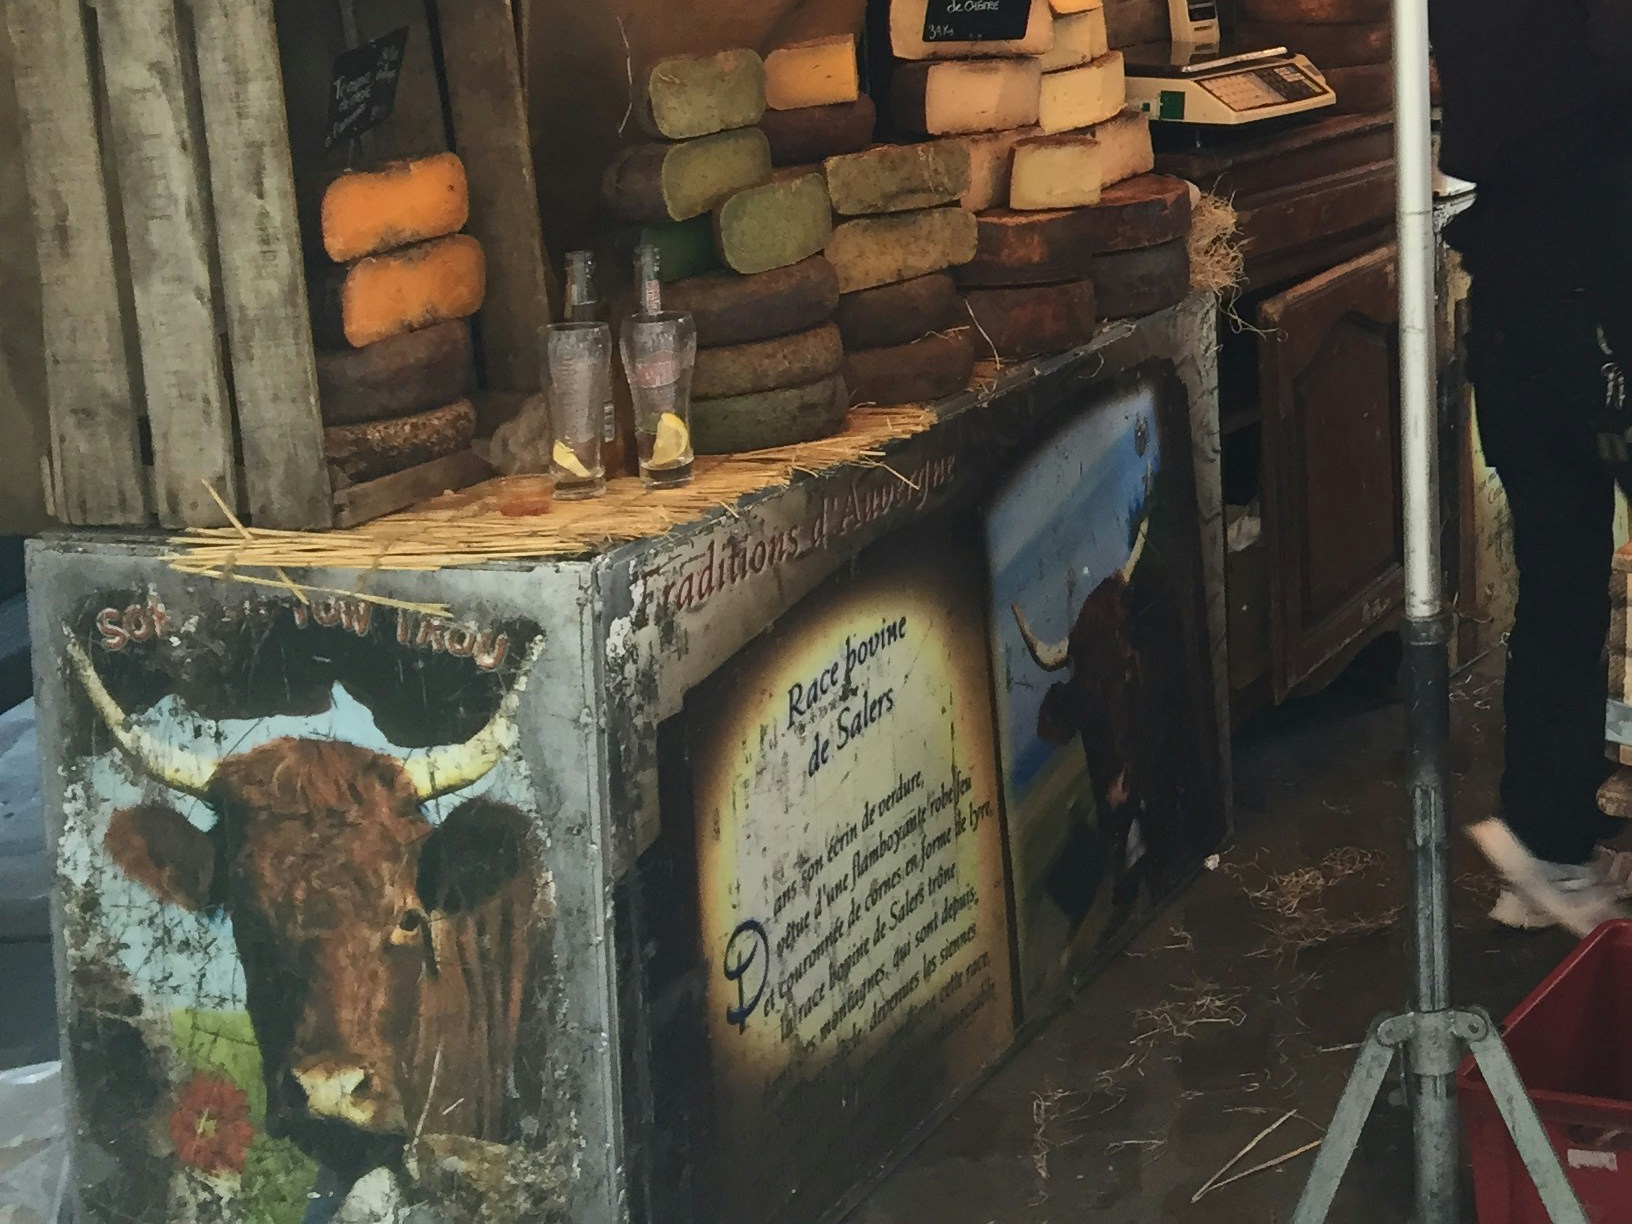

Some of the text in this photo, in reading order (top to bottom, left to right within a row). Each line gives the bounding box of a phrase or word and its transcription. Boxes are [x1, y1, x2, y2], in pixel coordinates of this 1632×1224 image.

[946, 0, 962, 14] de
[787, 616, 907, 732] Race bovine
[808, 687, 895, 777] de Salers
[862, 801, 877, 832] de
[878, 770, 924, 817] verdure,
[814, 873, 849, 920] d'une
[850, 805, 926, 893] flamboyante
[848, 897, 861, 929] de
[865, 866, 902, 913] cornes
[920, 827, 952, 873] forme
[799, 981, 825, 1024] race
[873, 914, 886, 947] de
[889, 887, 924, 931] Salers
[915, 911, 939, 948] sont
[923, 953, 937, 980] les
[940, 922, 976, 966] siennes
